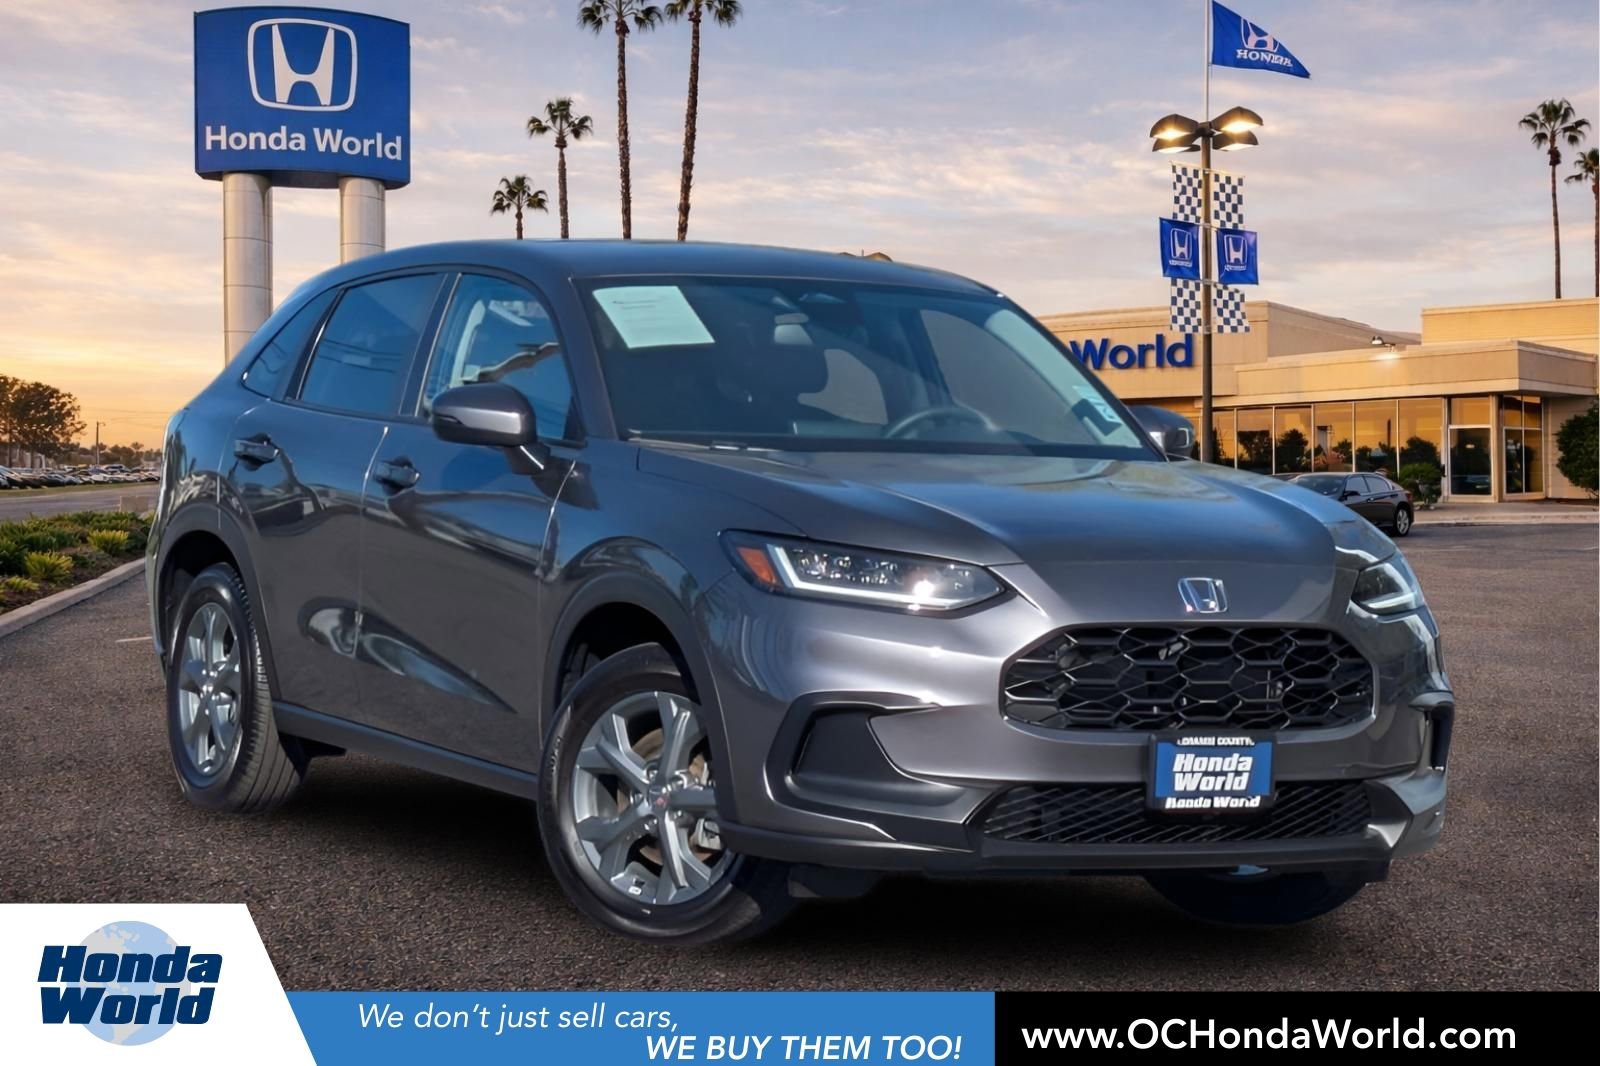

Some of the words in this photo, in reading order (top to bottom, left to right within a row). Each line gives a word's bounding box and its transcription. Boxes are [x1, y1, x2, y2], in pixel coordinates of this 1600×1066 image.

[205, 126, 305, 151] Honda
[313, 128, 402, 161] World
[1069, 333, 1193, 370] World
[1173, 753, 1253, 772] Honda
[1174, 772, 1250, 791] World
